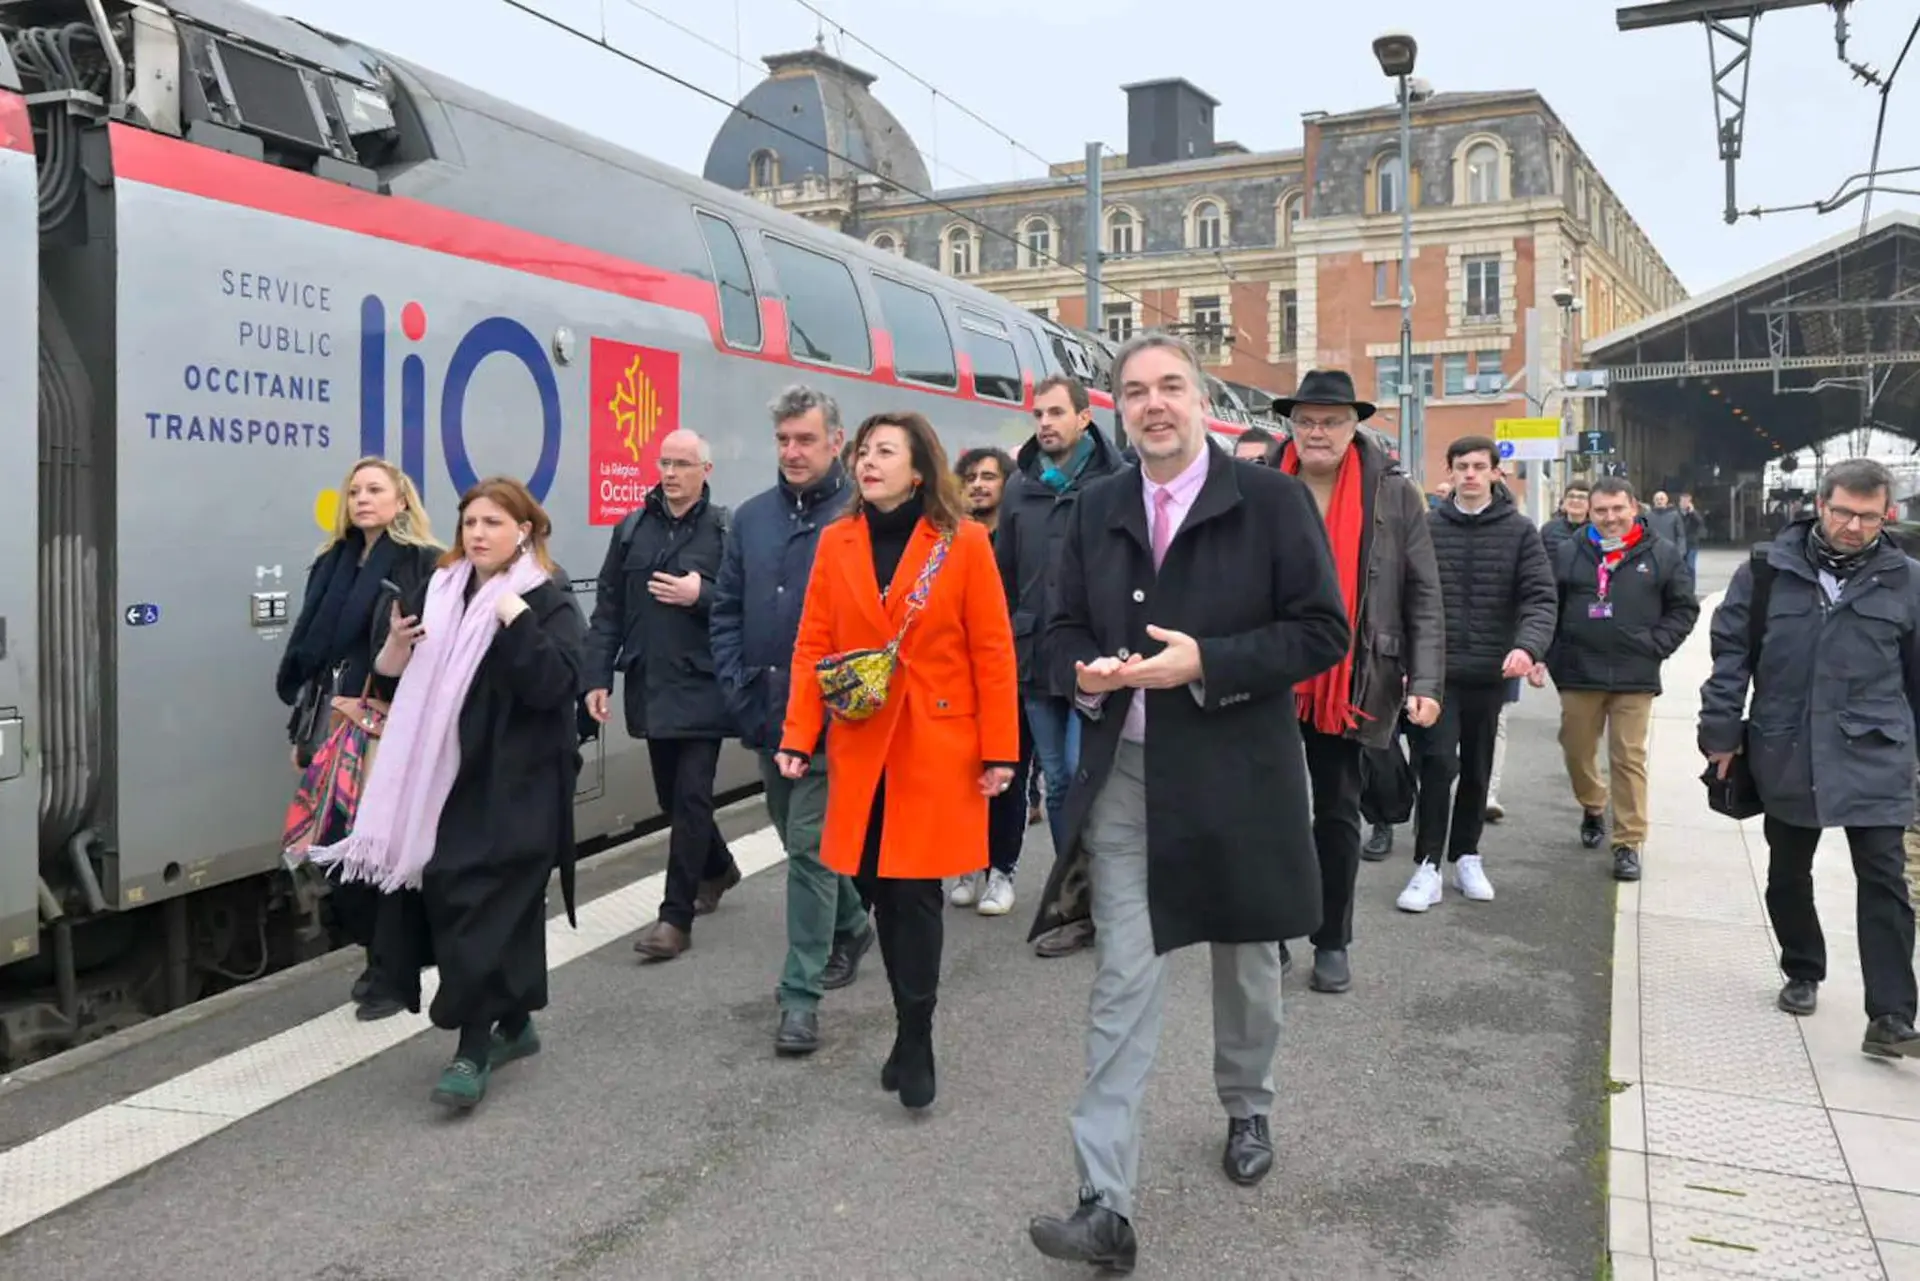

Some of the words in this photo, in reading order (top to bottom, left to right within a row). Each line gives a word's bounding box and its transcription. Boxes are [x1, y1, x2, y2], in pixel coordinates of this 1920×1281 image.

[221, 268, 331, 312] SERVICE
[239, 320, 331, 357] PUBLIC
[184, 364, 331, 403] OCCITANIE
[144, 412, 331, 449] TRANSPORTS
[600, 461, 611, 476] La
